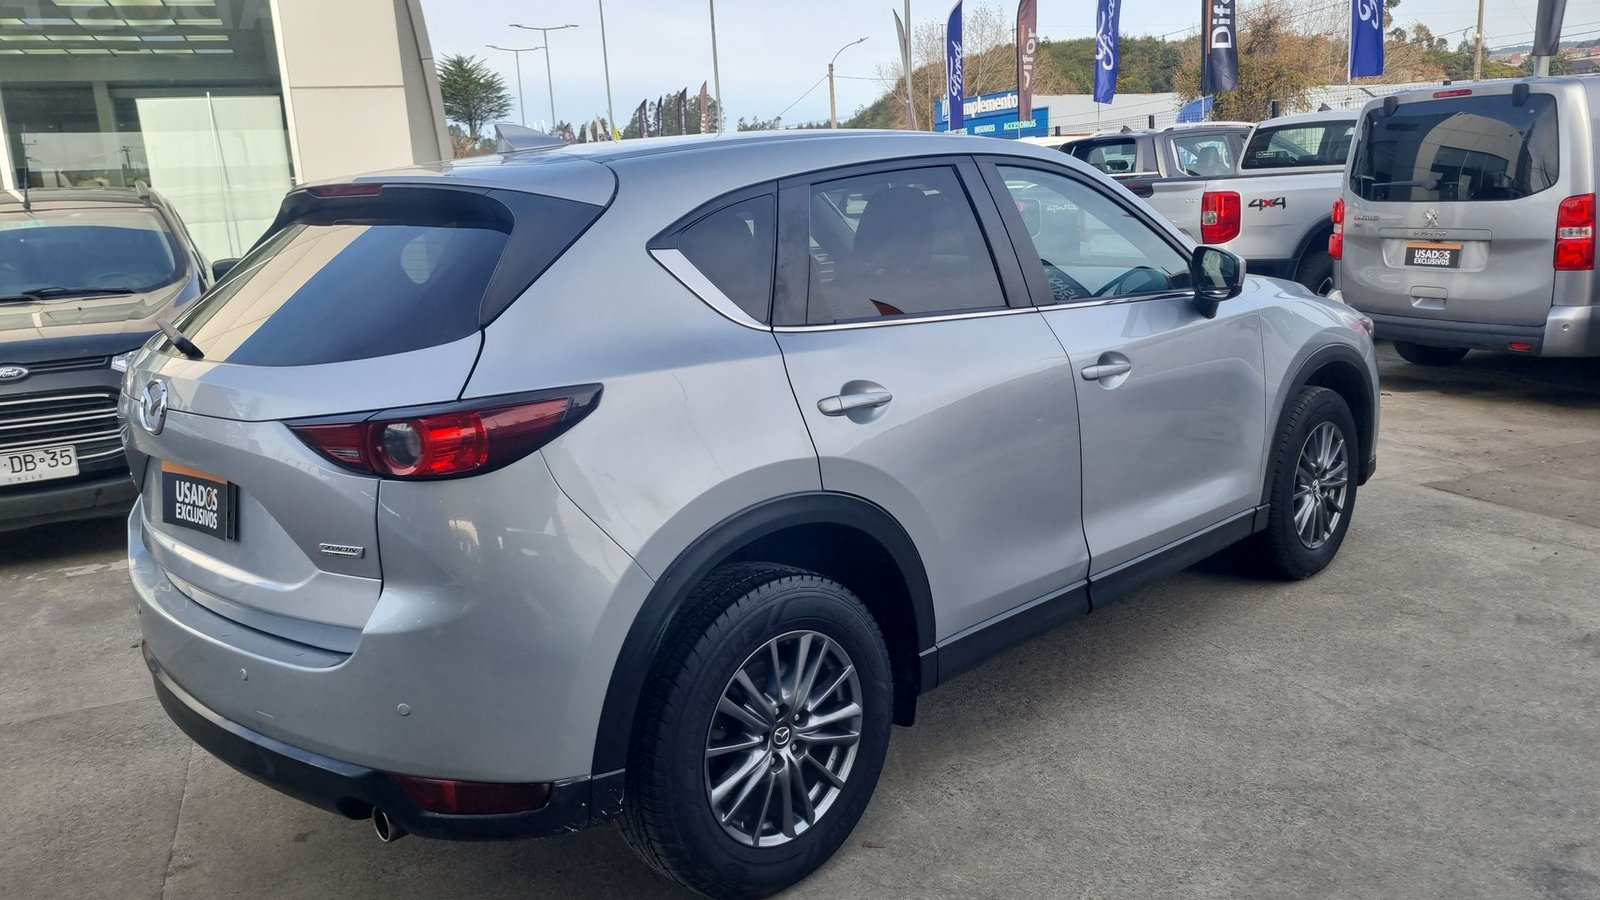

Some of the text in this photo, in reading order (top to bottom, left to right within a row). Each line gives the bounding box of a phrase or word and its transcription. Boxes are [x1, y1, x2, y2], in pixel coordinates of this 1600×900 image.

[1211, 0, 1232, 49] Dif
[950, 40, 962, 101] Ford
[963, 93, 1018, 118] mplemento
[1413, 257, 1450, 266] EXCLUSIVOS
[1414, 249, 1451, 260] USADOS
[175, 480, 218, 511] USADOS
[175, 502, 218, 530] EXCLUSIVOS
